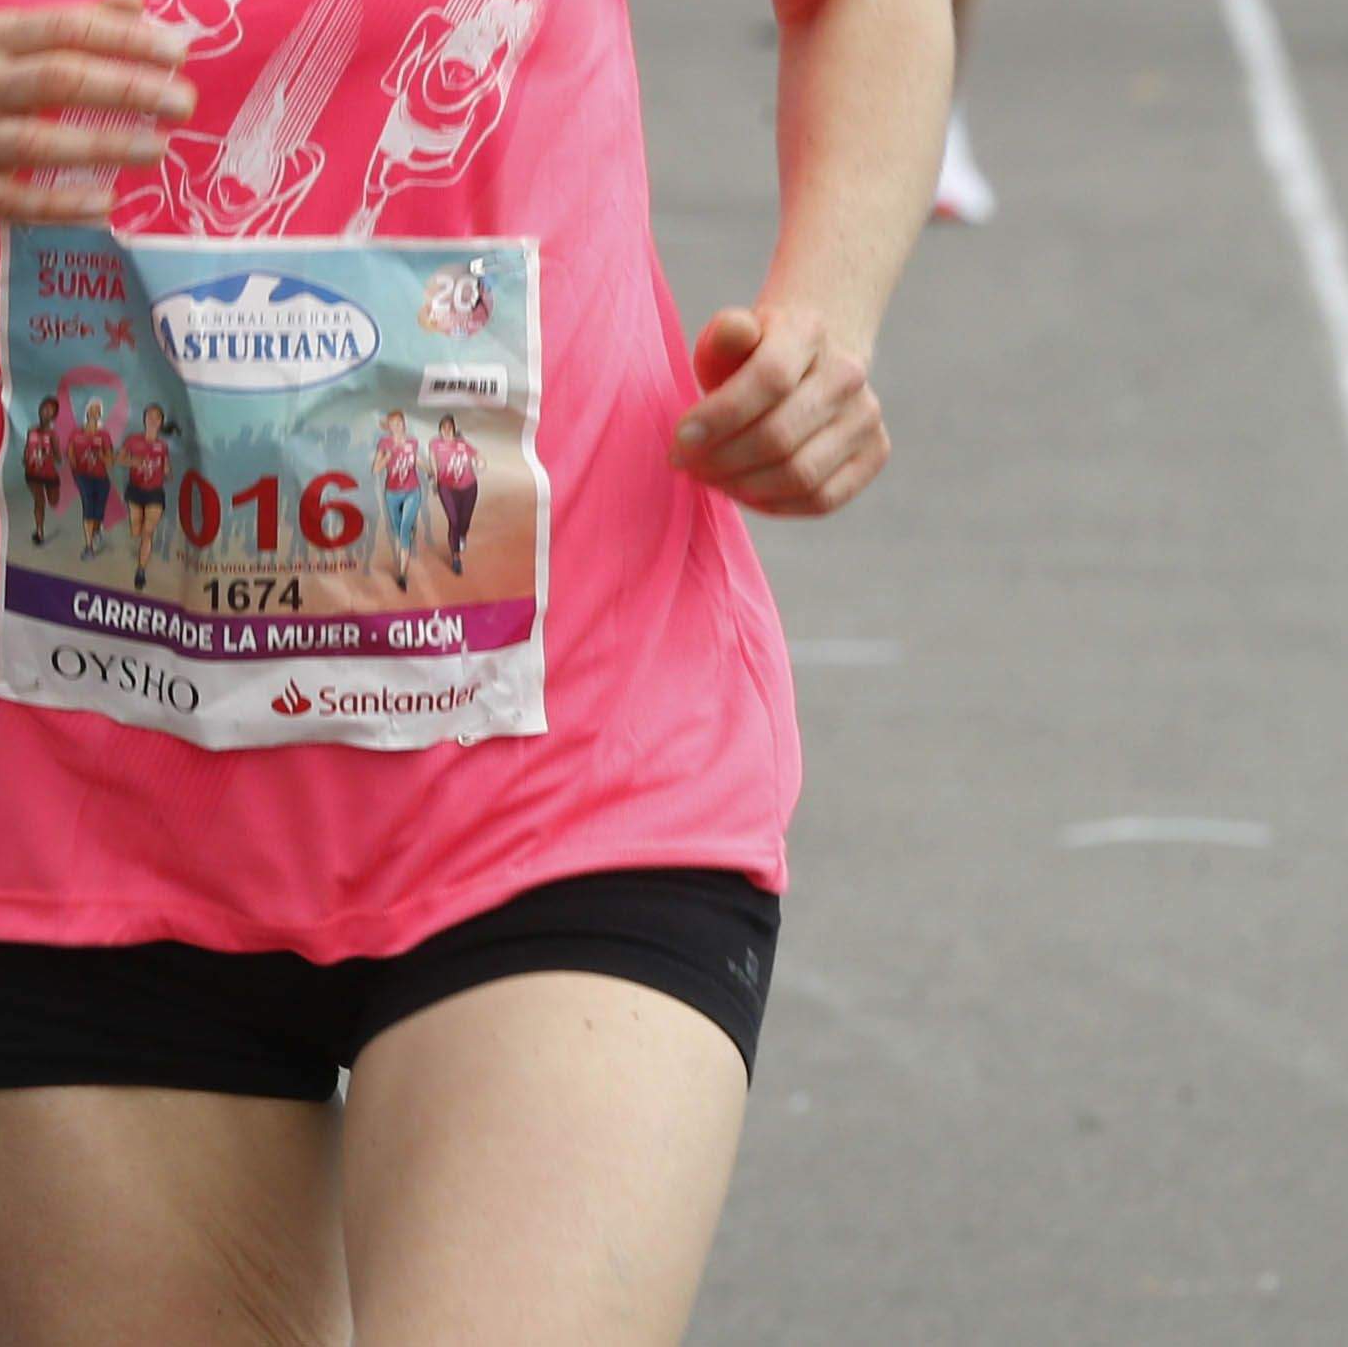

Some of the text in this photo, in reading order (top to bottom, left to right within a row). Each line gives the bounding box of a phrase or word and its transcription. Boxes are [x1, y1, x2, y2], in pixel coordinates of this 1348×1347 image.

[38, 269, 127, 303] SUMA
[429, 272, 479, 313] 20
[159, 313, 362, 362] ASTURIANA
[186, 310, 265, 326] CENTRAL
[178, 468, 365, 552] 016
[203, 576, 304, 613] 1674
[73, 590, 182, 643] CARRERA
[223, 624, 257, 652] LA
[266, 621, 361, 652] MUJER
[388, 608, 463, 650] GIJÓN
[51, 644, 200, 715] OYSHO
[318, 681, 482, 717] Santander
